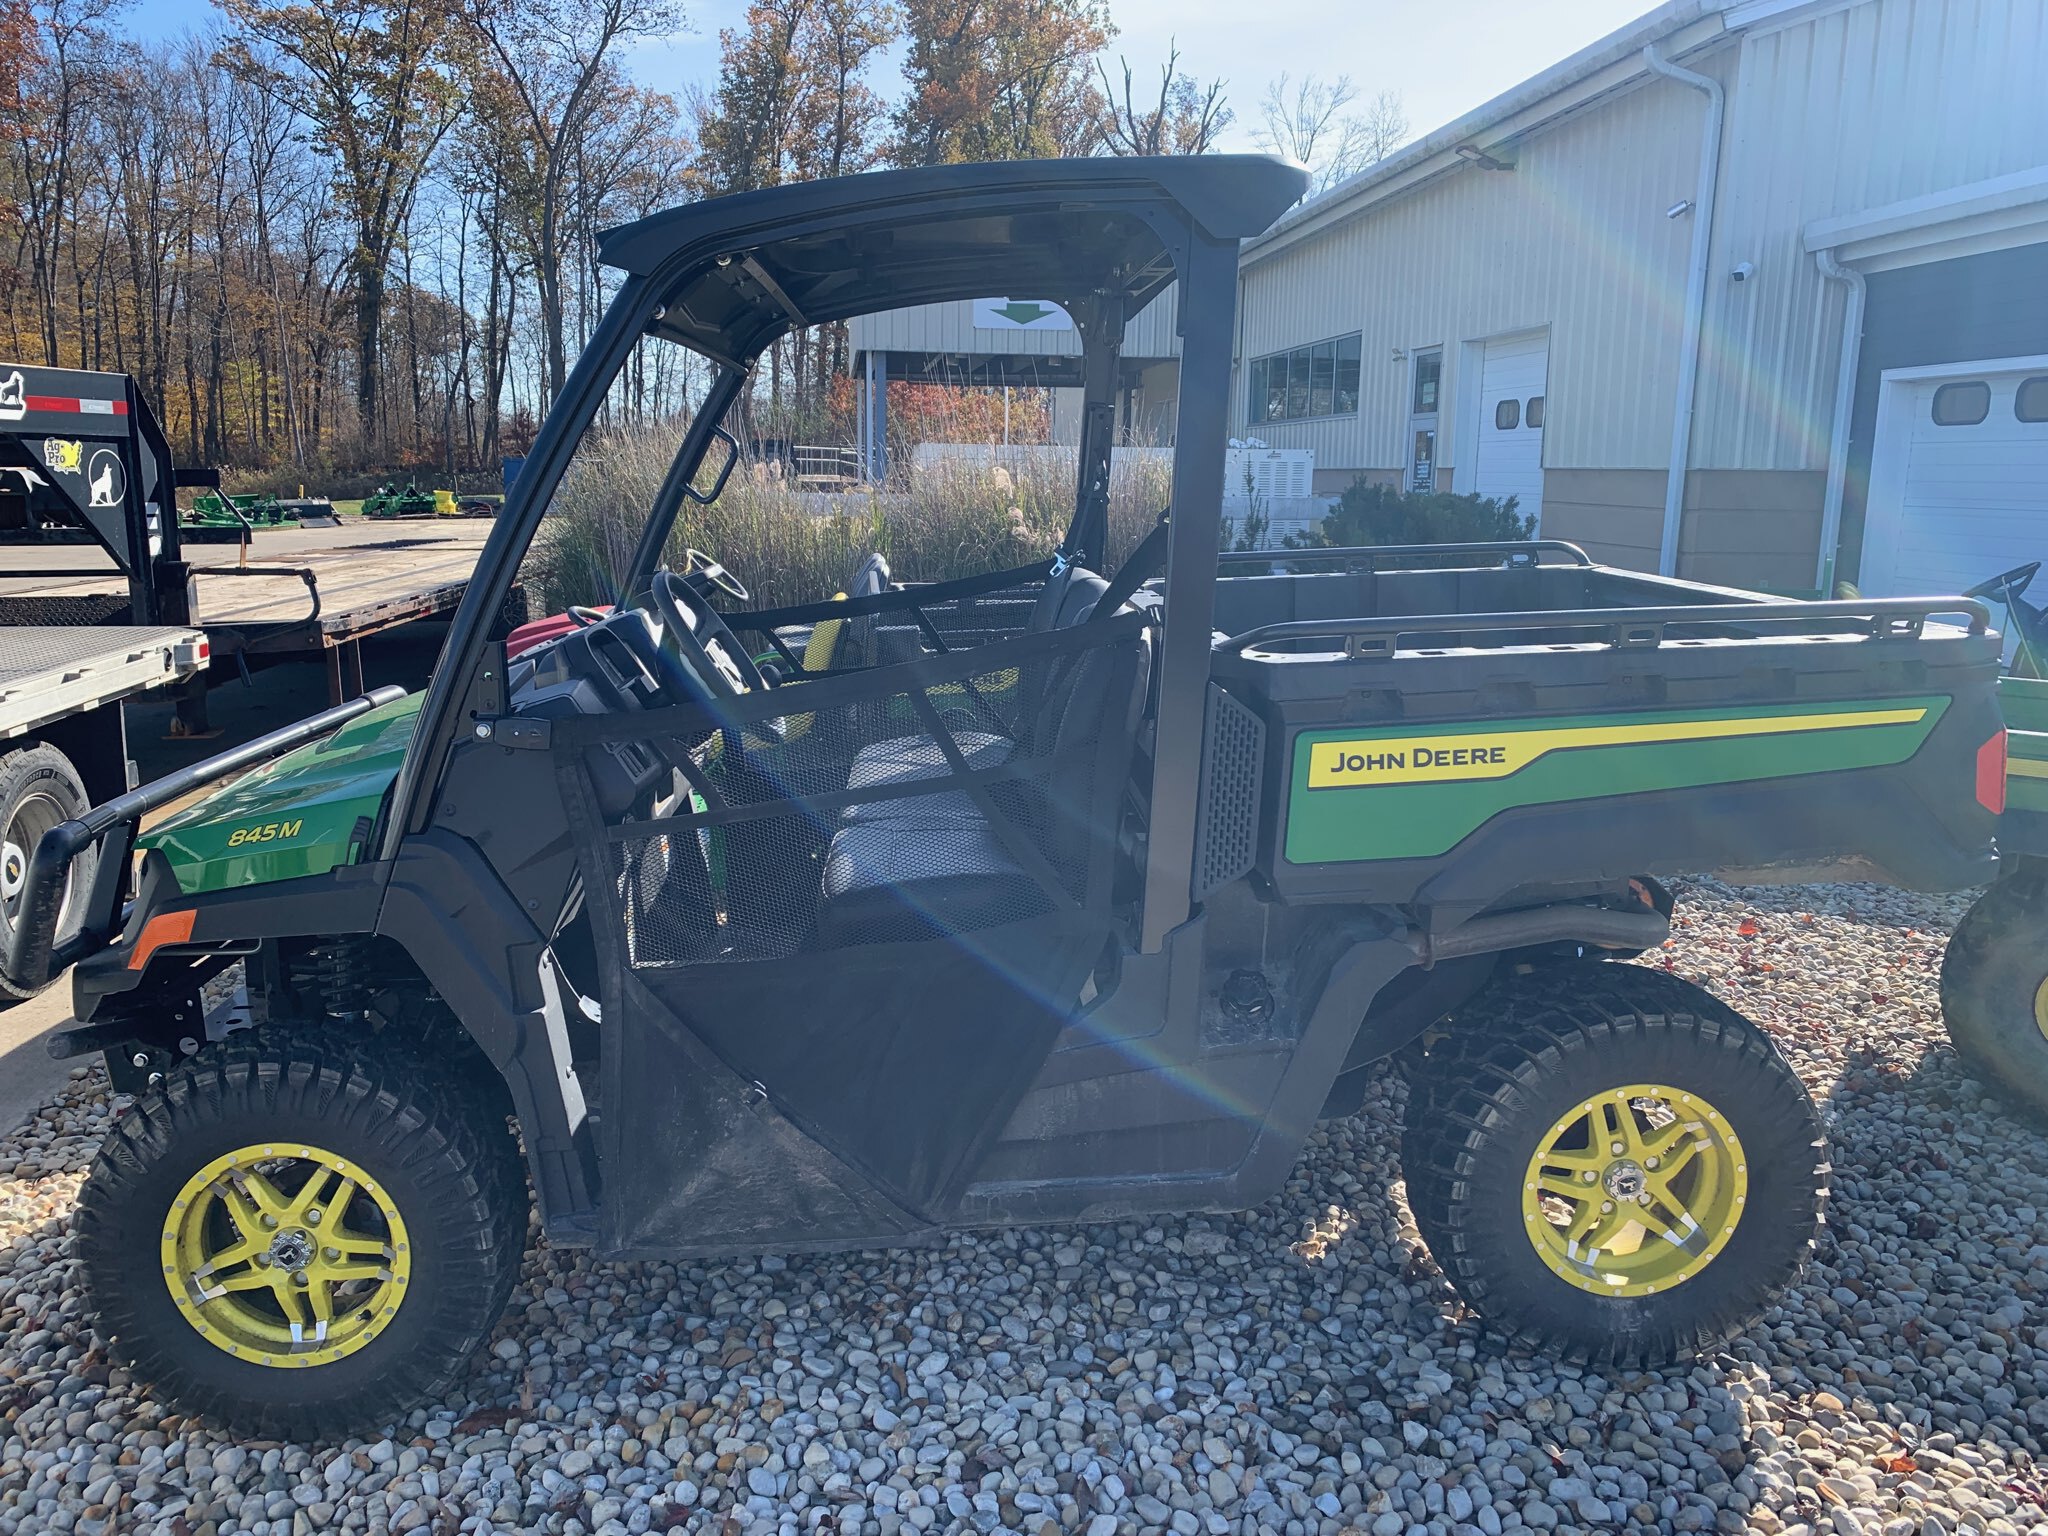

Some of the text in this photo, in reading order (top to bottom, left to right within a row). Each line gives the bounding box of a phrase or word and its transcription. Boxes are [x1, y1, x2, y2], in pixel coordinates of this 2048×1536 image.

[48, 452, 65, 464] Pro
[1330, 747, 1506, 773] JOHN DEERE
[227, 818, 304, 847] 845M
